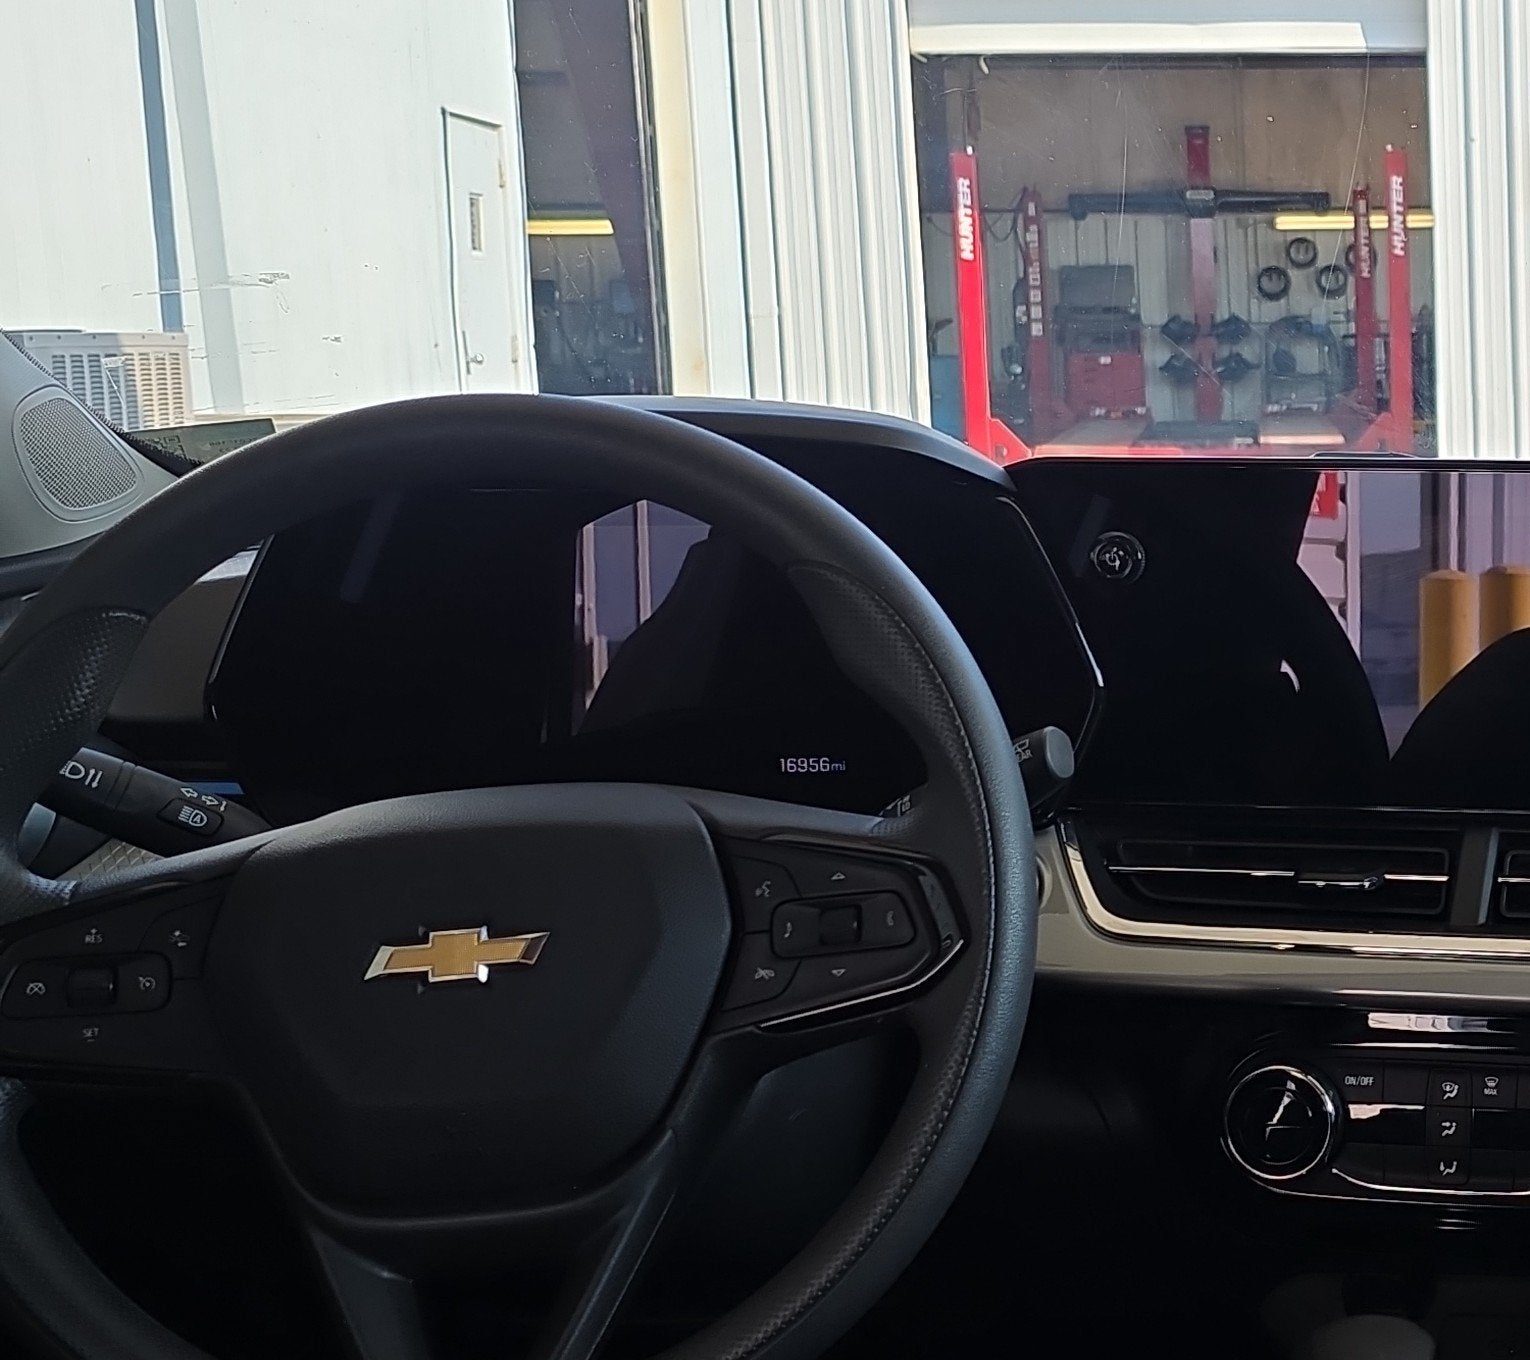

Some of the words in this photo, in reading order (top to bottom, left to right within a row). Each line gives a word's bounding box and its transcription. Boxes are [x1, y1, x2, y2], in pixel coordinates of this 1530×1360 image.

[957, 177, 975, 261] HUNTER
[1390, 175, 1406, 256] HUNTER
[82, 1027, 99, 1038] SET
[1344, 1075, 1375, 1086] ON/OFF
[1483, 1088, 1498, 1096] MAX
